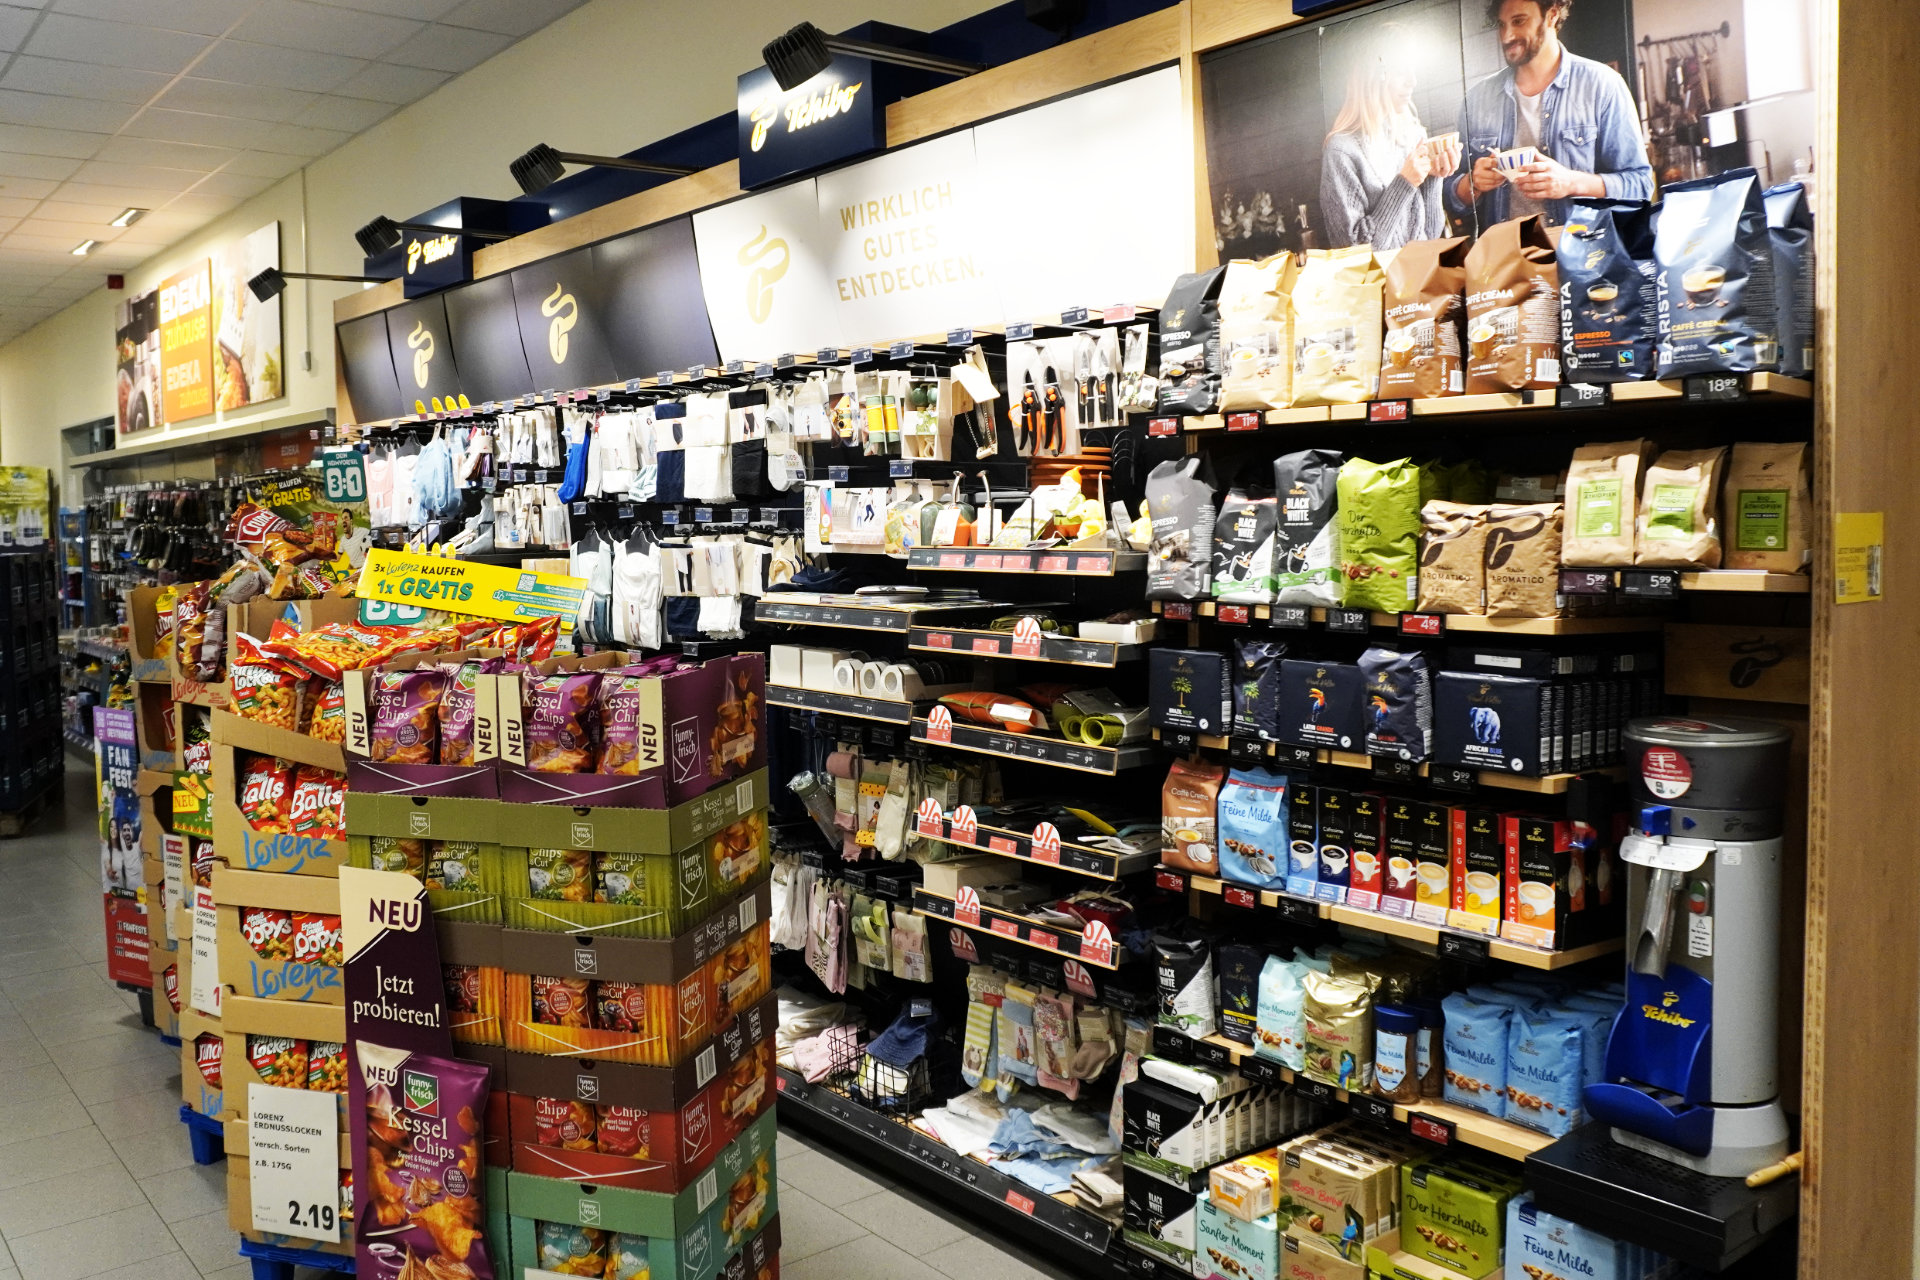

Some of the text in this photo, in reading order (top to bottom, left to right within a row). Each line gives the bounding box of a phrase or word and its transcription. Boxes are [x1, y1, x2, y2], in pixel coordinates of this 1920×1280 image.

[784, 81, 863, 133] Tchibo
[840, 182, 953, 232] WIRKLICH
[423, 235, 458, 264] Tchibo
[864, 225, 939, 262] GUTES
[837, 254, 985, 302] ENTDECKEN.
[159, 270, 212, 324] EDEKA
[1481, 288, 1514, 301] CREMA
[1403, 302, 1433, 314] CREMA
[1657, 270, 1674, 365] BARISTA
[165, 315, 207, 352] zuhause
[1559, 281, 1578, 369] BARISTA
[1672, 320, 1695, 332] CAFFÈ
[1573, 330, 1611, 341] ESPRESSO
[166, 359, 201, 392] EDEKA
[279, 477, 302, 490] KAUFEN
[272, 486, 312, 508] GRATIS
[1286, 497, 1311, 510] BLACK
[1151, 516, 1179, 529] ESPRESSO
[1238, 517, 1258, 529] BLACK
[1286, 509, 1310, 522] WHITE
[1346, 510, 1367, 523] Der
[1237, 528, 1255, 540] WHITE
[421, 564, 465, 577] KAUFEN
[1422, 573, 1471, 583] AROMATICO
[1491, 575, 1545, 585] AROMATICO
[399, 577, 474, 602] GRATIS
[368, 689, 408, 708] Kessel
[522, 689, 564, 710] Kessel
[377, 705, 410, 724] Chips
[533, 708, 565, 727] Chips
[351, 711, 367, 749] NEU
[477, 716, 493, 755] NEU
[506, 718, 523, 757] NEU
[642, 722, 658, 763] NEU
[678, 738, 697, 759] frisch
[1465, 744, 1503, 755] AFRICAN BLUE
[107, 745, 131, 768] FAN
[109, 766, 133, 790] FEST
[174, 794, 195, 809] NEU
[289, 785, 343, 820] Balls
[702, 792, 723, 813] Kessel
[1171, 787, 1192, 799] Caffè
[1222, 800, 1274, 824] Feine Milde
[1322, 826, 1345, 835] Cafissimo
[1353, 832, 1377, 841] Cafissimo
[1390, 837, 1414, 846] Cafissimo
[1420, 843, 1445, 853] Cafissimo
[242, 830, 333, 873] Lorenz
[1469, 851, 1495, 862] Cafissimo
[681, 853, 702, 870] funny-
[1523, 861, 1550, 871] Cafissimo
[685, 863, 703, 884] frisch
[196, 910, 216, 922] LORENZ
[369, 897, 419, 929] NEU
[249, 960, 342, 1001] Lorenz
[375, 965, 414, 999] Jetzt
[1158, 966, 1175, 979] BLACK
[680, 980, 701, 1000] funny-
[1160, 977, 1176, 989] WHITE
[353, 995, 441, 1028] probieren!
[683, 991, 702, 1015] frisch
[1271, 1005, 1297, 1018] Moment
[1641, 1004, 1696, 1029] Tchibo
[1467, 1049, 1497, 1067] Milde
[366, 1064, 398, 1086] NEU
[407, 1074, 433, 1090] funny-
[1527, 1065, 1560, 1084] Milde
[410, 1086, 434, 1101] frisch
[253, 1111, 285, 1123] LORENZ
[536, 1100, 568, 1119] Chips
[684, 1101, 706, 1122] funny-
[1146, 1109, 1161, 1122] BLACK
[253, 1120, 322, 1137] ERDNUSSLOCKEN
[387, 1106, 448, 1141] Kessel
[687, 1112, 708, 1138] frisch
[1146, 1119, 1161, 1132] WHITE
[254, 1140, 311, 1155] versch. Sorten
[413, 1135, 455, 1164] Chips
[255, 1159, 292, 1171] z.B. 175G
[397, 1150, 439, 1168] Sweet Roasted
[404, 1160, 420, 1170] Onion
[1148, 1192, 1163, 1204] BLACK
[1148, 1201, 1163, 1214] WHITE
[288, 1200, 334, 1231] 2.19
[1406, 1193, 1429, 1214] Der
[1430, 1203, 1489, 1238] Herzhafte
[688, 1235, 708, 1260] frisch
[1200, 1219, 1266, 1263] Sanfter Moment
[1523, 1233, 1595, 1277] Feine Milde
